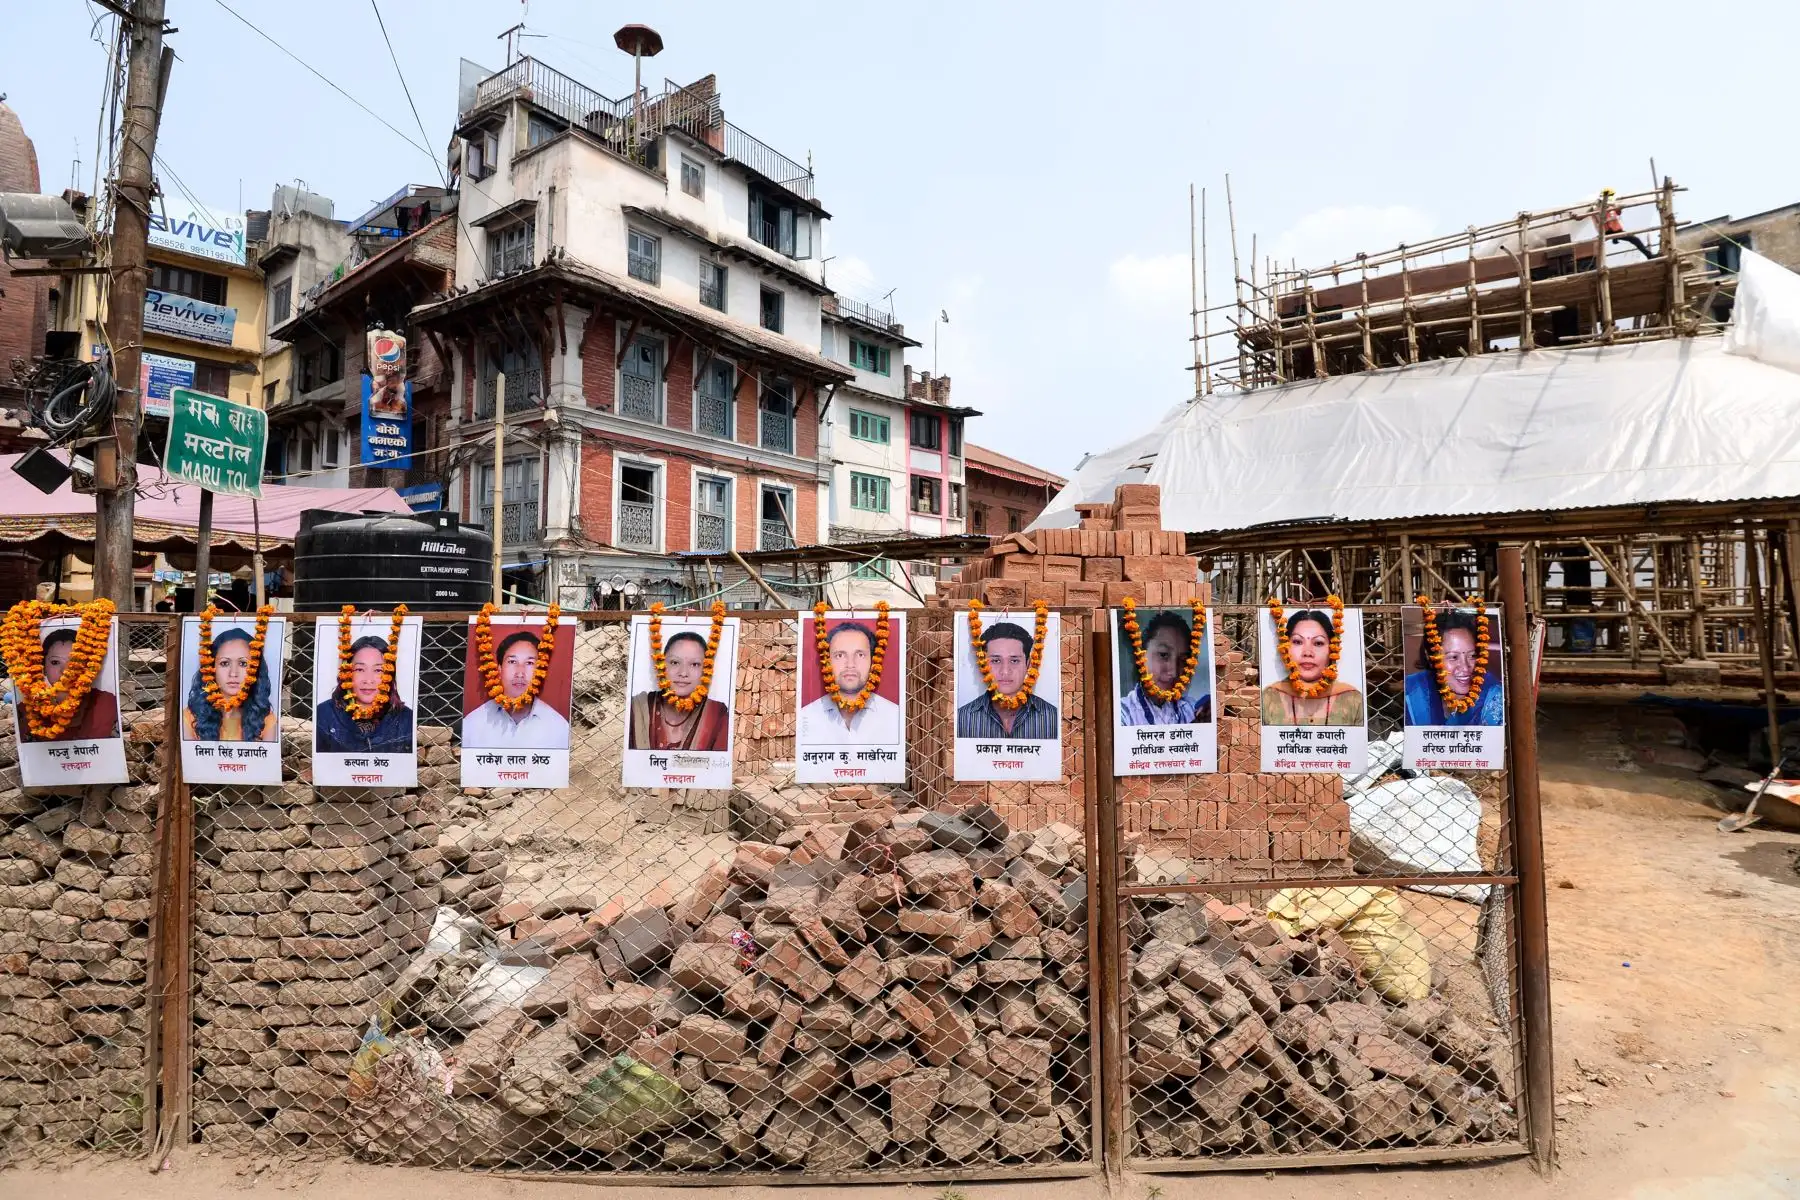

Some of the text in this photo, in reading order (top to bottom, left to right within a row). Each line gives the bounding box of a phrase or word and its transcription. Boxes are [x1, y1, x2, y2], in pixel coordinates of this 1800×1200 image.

[149, 213, 233, 249] evive
[145, 291, 217, 324] Revive
[376, 363, 400, 372] pepsi
[181, 460, 251, 492] MARU TOL
[421, 541, 466, 554] Hilltake
[421, 566, 438, 574] EXTRA
[438, 566, 454, 574] HEAVY
[1137, 728, 1193, 741] सिमरन डंगोल
[1316, 729, 1346, 740] कपाली
[1422, 730, 1460, 741] लालमाया
[48, 744, 99, 759] मञ्जु नेपाली
[195, 745, 214, 757] निमा
[237, 746, 267, 758] प्रजापति
[976, 744, 1041, 756] प्रकाश मानन्धर
[1131, 744, 1165, 756] प्राविधिक
[1277, 743, 1312, 755] प्राविधिक
[1422, 743, 1483, 755] वरिष्ठ प्राविधिक
[344, 757, 389, 767] कल्पना श्रेष्ठ
[476, 752, 550, 765] राकेश लाल श्रेष्ठ
[649, 754, 668, 770] निलु
[803, 751, 835, 765] अनुराग
[857, 748, 897, 763] माखेरिया
[60, 762, 91, 771] रक्तदाता
[218, 763, 247, 772] रक्तदाता
[992, 760, 1024, 770] रक्तदाता
[1189, 758, 1202, 768] सेवा
[1337, 760, 1351, 769] सेवा
[1476, 758, 1489, 768] सेवा
[351, 774, 383, 783] रक्तदाता
[497, 771, 529, 780] रक्तदाता
[833, 768, 866, 778] रक्तदाता
[663, 774, 696, 784] रक्तदाता
